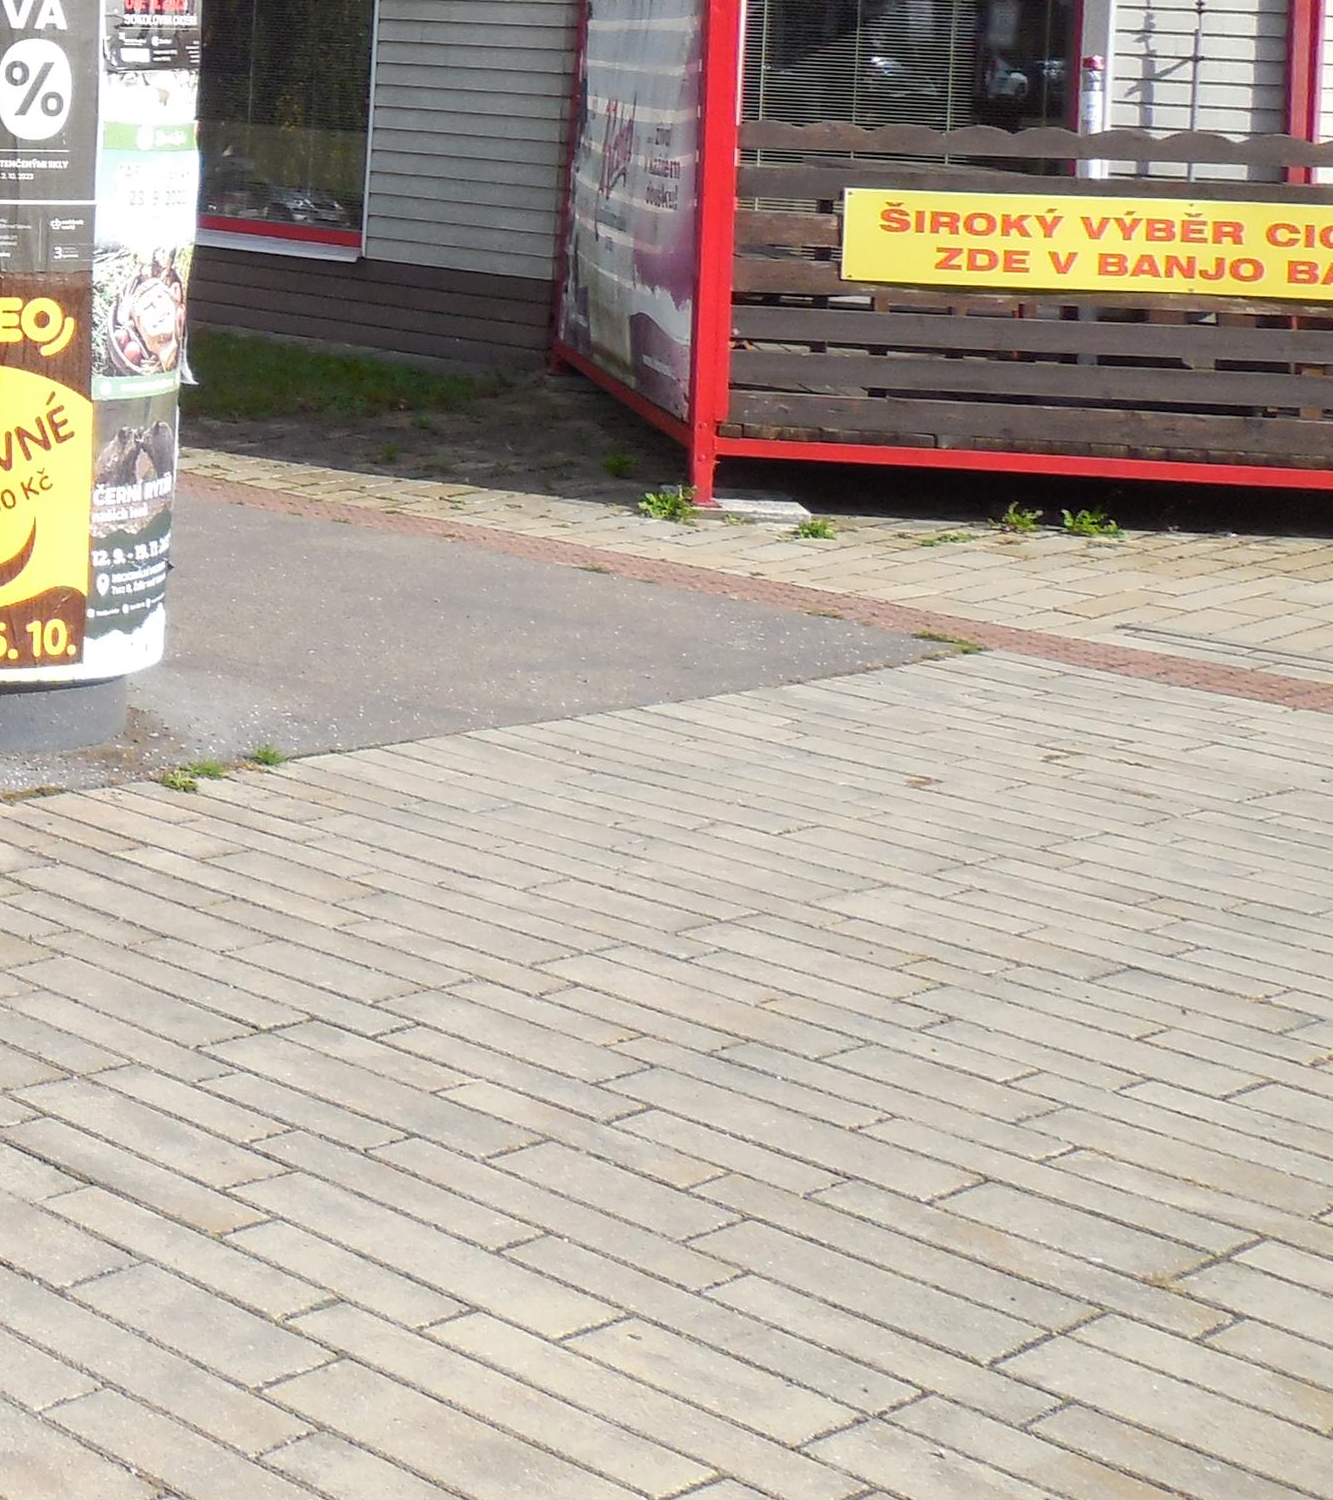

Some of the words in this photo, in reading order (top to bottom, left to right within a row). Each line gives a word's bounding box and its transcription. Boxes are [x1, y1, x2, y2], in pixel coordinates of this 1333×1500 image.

[879, 202, 1064, 240] ŠIROKÝ
[1080, 210, 1244, 246] VÝBĚR
[934, 246, 1030, 275] ZDE
[1047, 251, 1079, 275] V
[1097, 252, 1265, 283] BANJO
[20, 467, 54, 502] Kč
[25, 617, 77, 657] 10.
